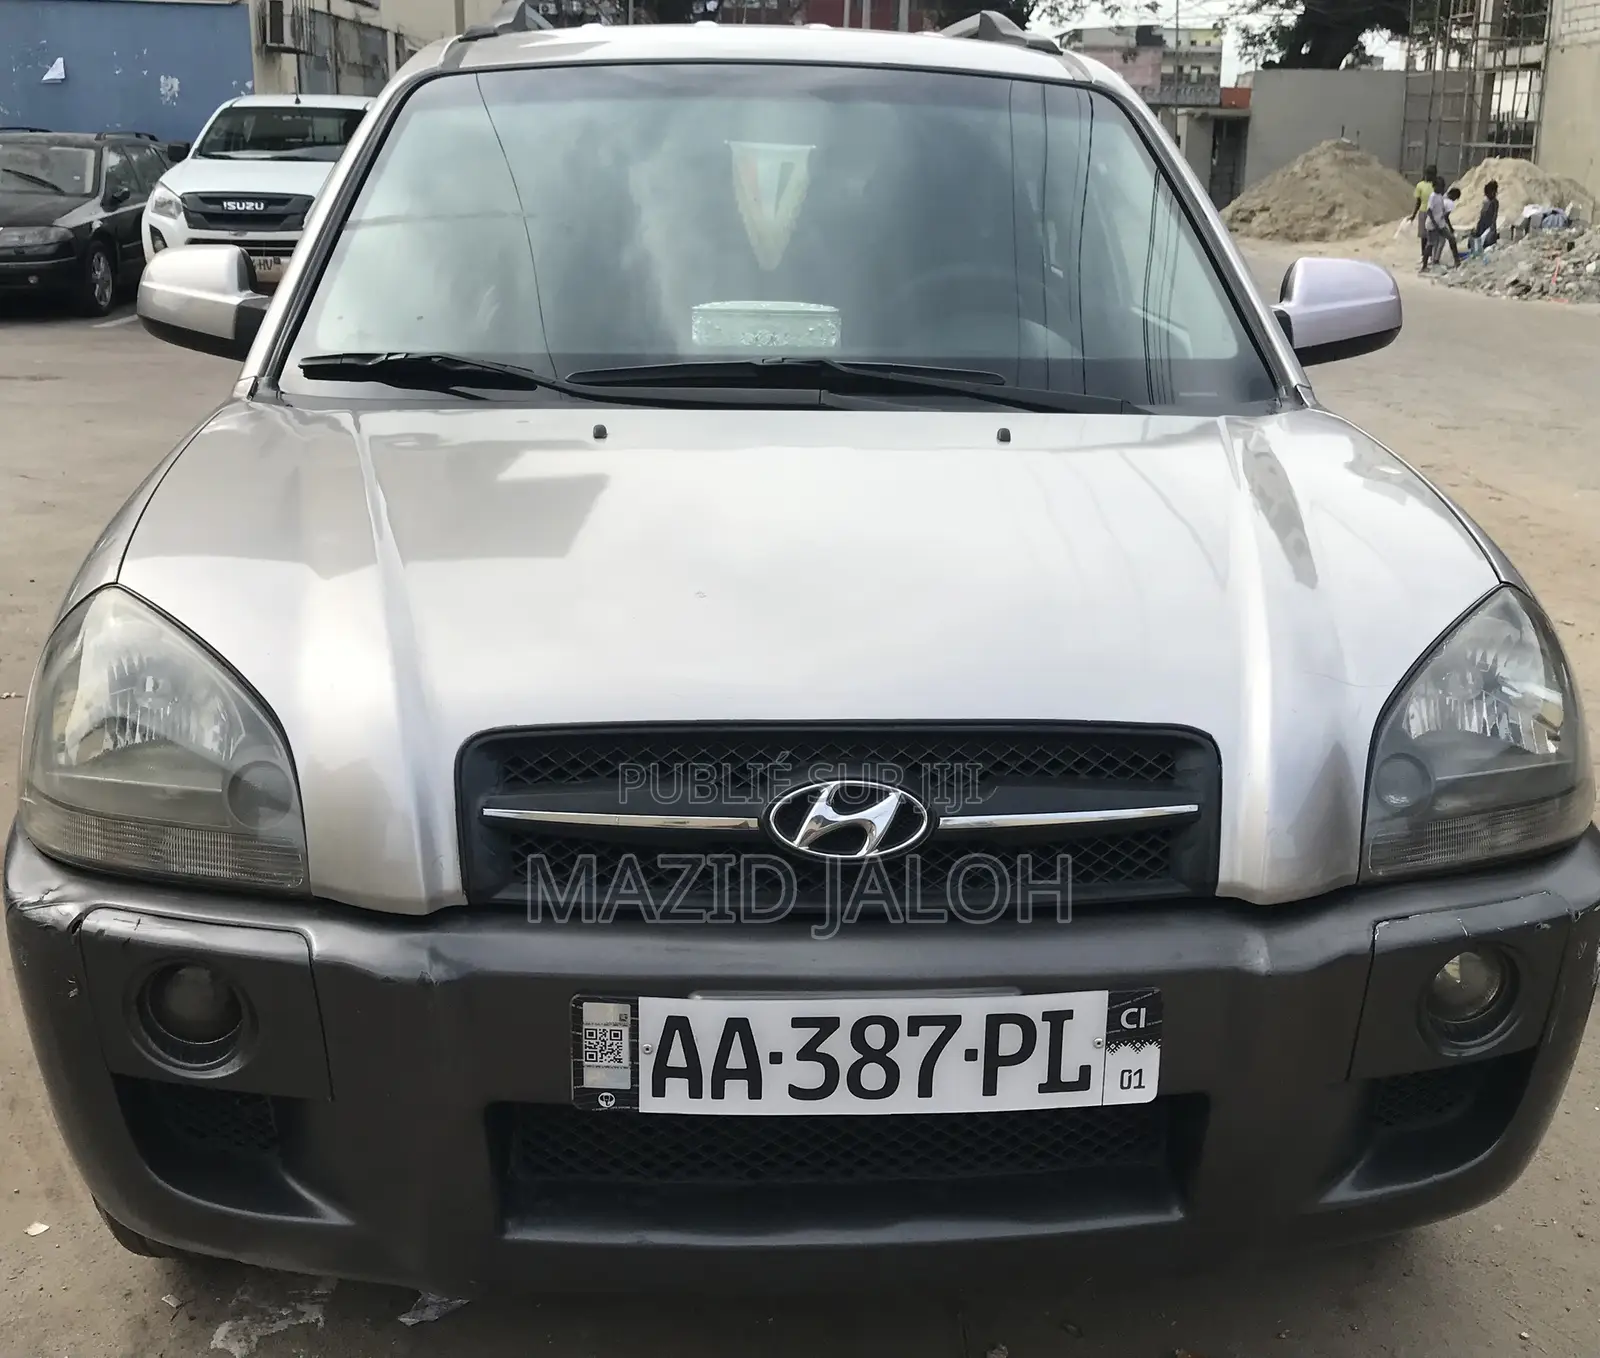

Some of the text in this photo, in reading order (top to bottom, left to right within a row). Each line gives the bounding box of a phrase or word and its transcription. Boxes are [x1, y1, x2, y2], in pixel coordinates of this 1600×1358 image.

[223, 201, 264, 210] ISUZU
[1121, 1008, 1146, 1029] CI
[1120, 1069, 1145, 1090] 01
